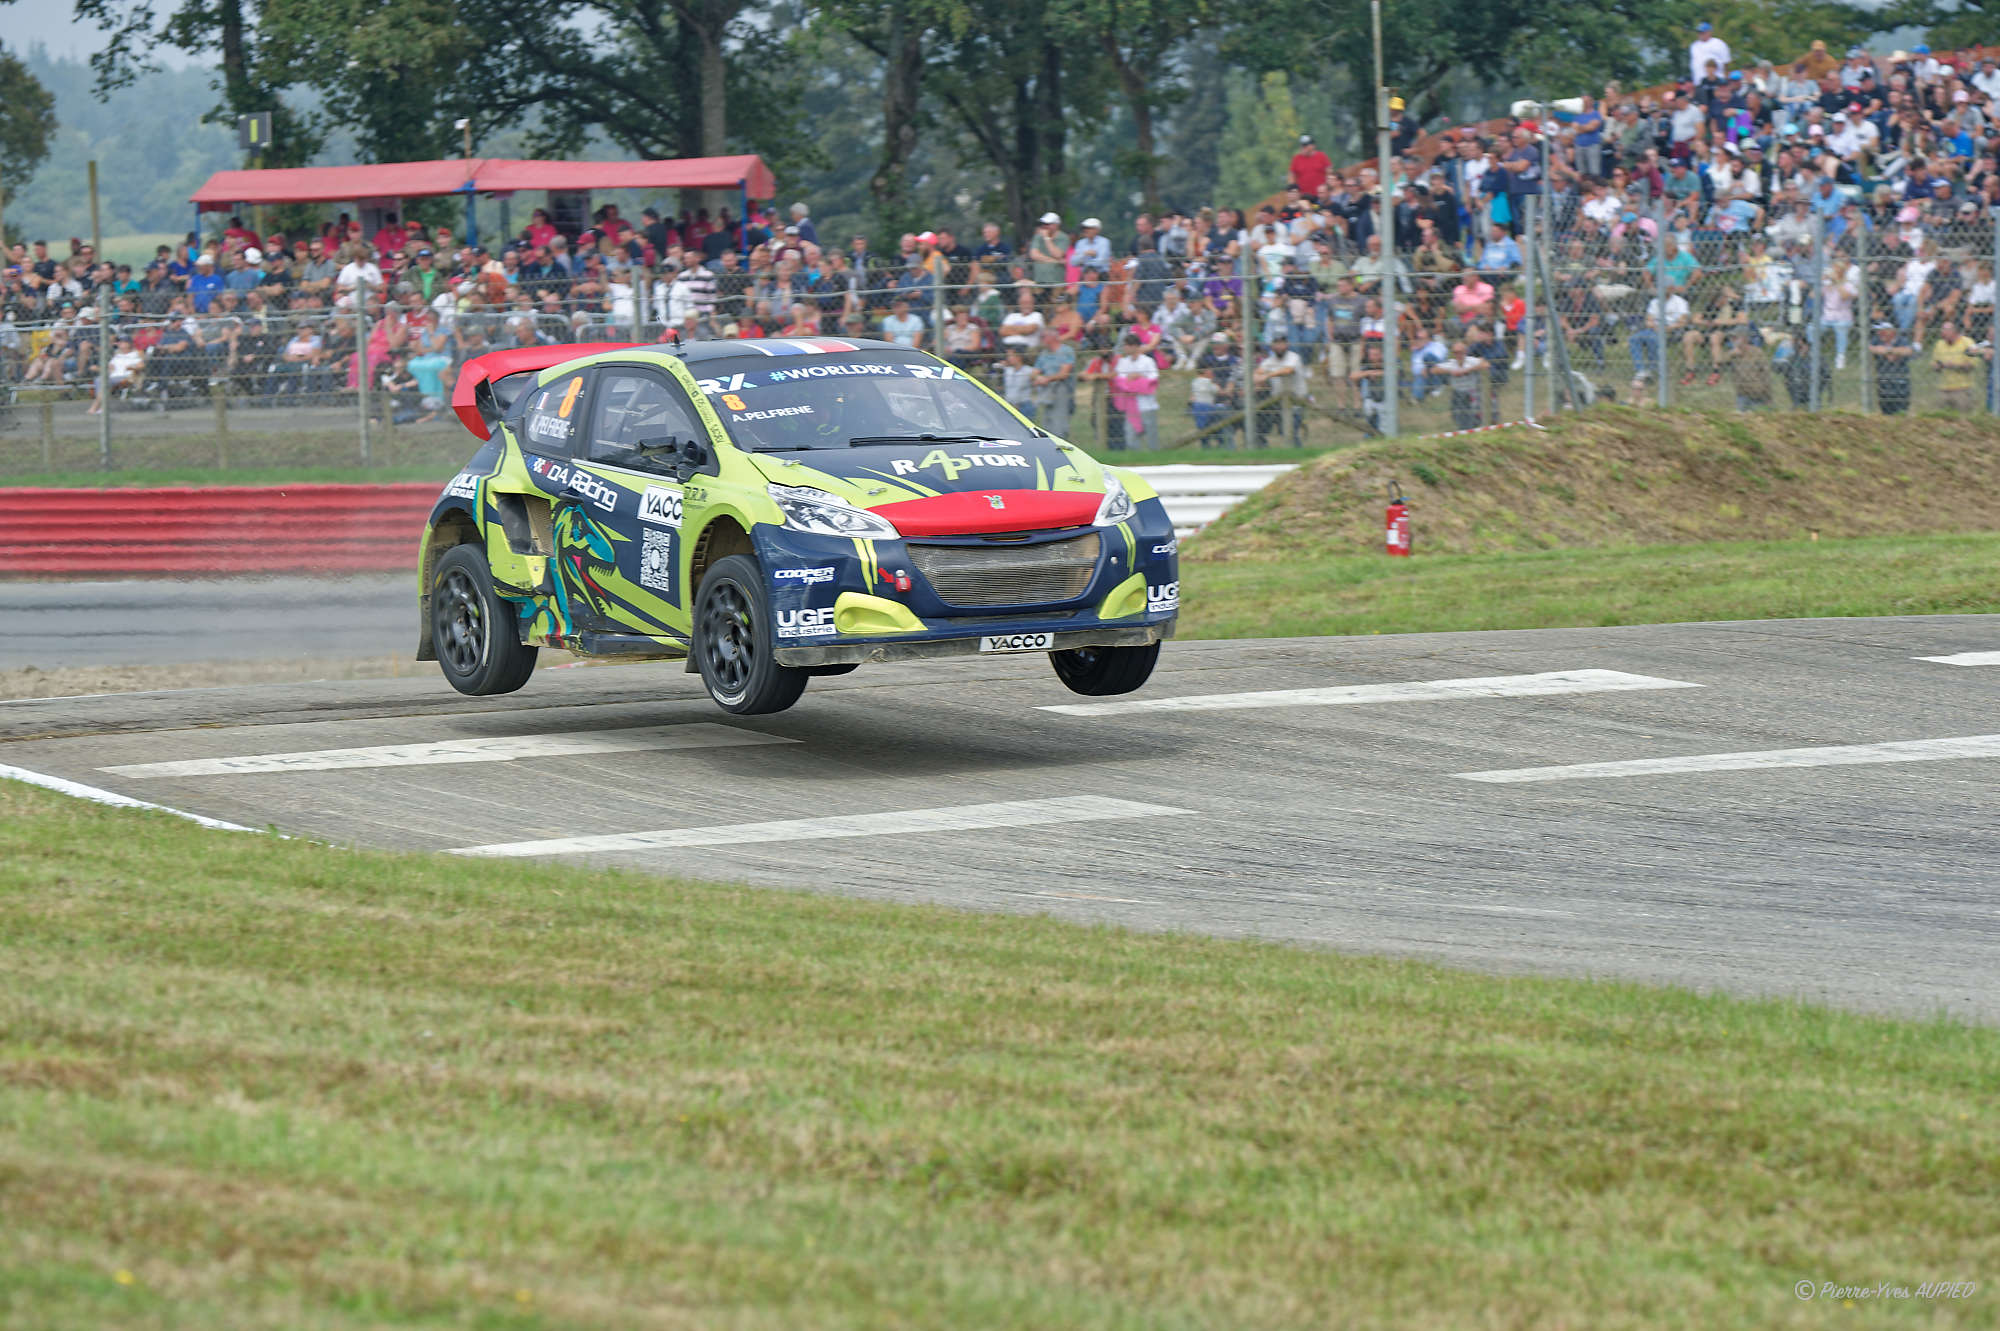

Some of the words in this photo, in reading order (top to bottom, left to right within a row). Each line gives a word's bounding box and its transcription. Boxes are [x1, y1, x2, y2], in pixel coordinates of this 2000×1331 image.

[769, 364, 899, 382] #WORLDRX
[558, 376, 583, 418] 8
[721, 394, 747, 411] 8
[890, 450, 1031, 480] RAPTOR
[774, 567, 835, 578] COOPER
[776, 607, 834, 626] UGF
[989, 634, 1046, 649] YACCO
